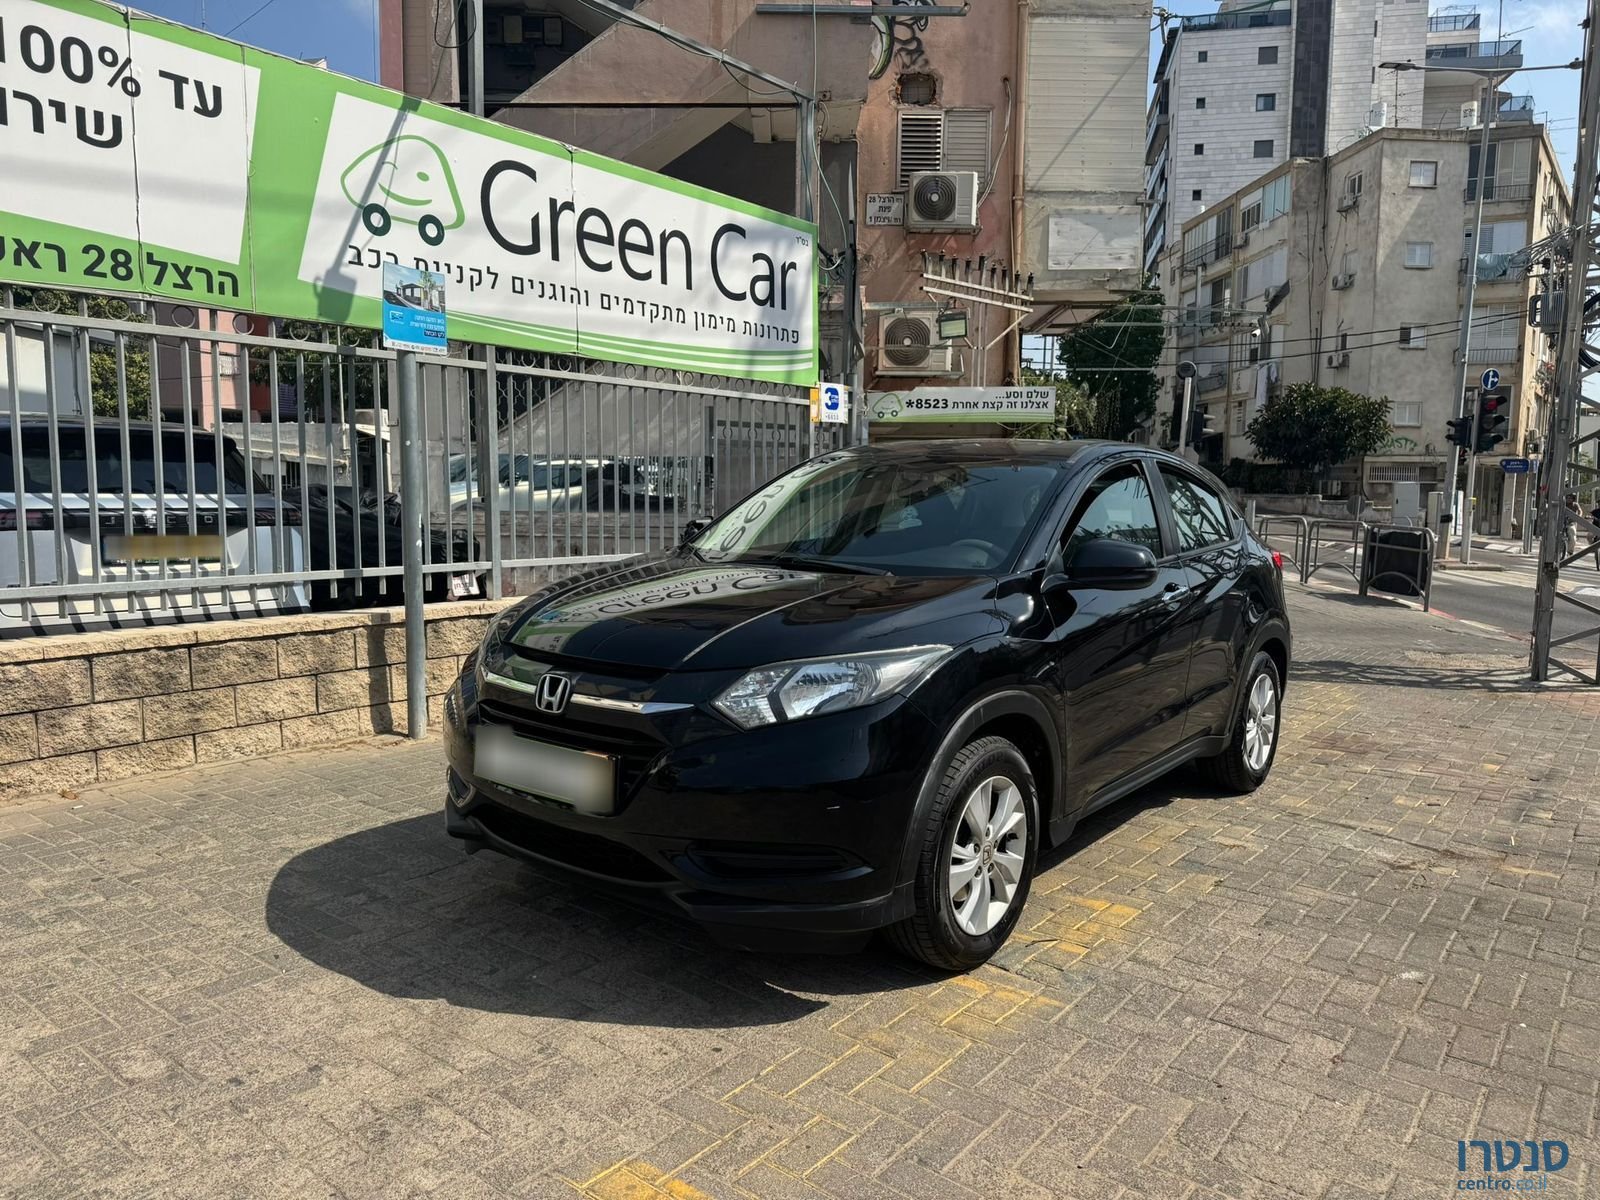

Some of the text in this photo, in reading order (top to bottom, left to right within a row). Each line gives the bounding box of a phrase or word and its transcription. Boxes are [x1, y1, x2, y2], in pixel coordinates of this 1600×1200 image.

[159, 69, 222, 118] עד
[480, 159, 797, 311] Green Car
[0, 235, 239, 298] הרצל 28 רא
[511, 275, 589, 307] והוגנים
[600, 292, 686, 324] מתקדמים
[694, 310, 736, 333] מימון
[742, 320, 799, 344] פתרונות
[951, 401, 979, 409] אחרת
[1006, 401, 1019, 409] זה
[1020, 400, 1049, 409] אצלנו
[1026, 389, 1049, 399] שלם
[982, 401, 1003, 411] קצת
